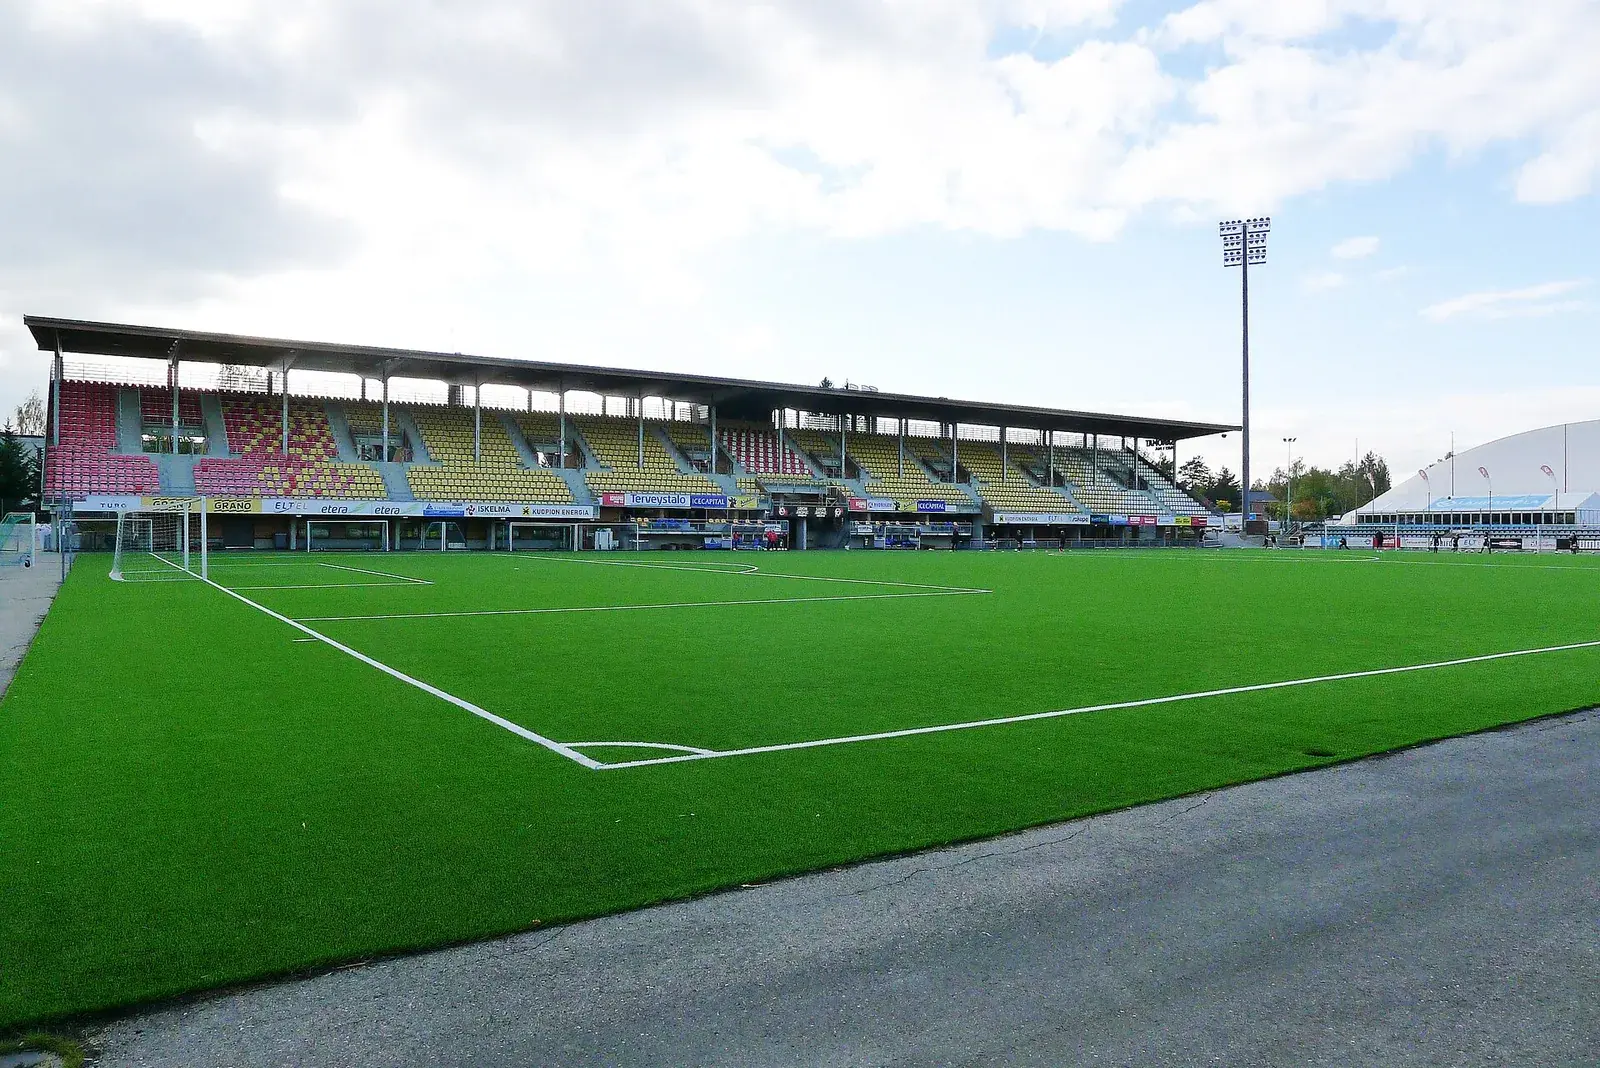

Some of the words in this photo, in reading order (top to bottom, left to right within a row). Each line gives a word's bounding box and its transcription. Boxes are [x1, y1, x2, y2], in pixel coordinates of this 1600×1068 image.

[631, 494, 686, 505] Terveystalo
[691, 497, 725, 505] ICECAPITAL
[214, 502, 252, 510] GRANO
[274, 502, 308, 510] ELTEL
[321, 505, 348, 514] etera
[374, 506, 400, 515] etera
[532, 508, 560, 516] KUOPION
[561, 508, 589, 516] ENERGIA
